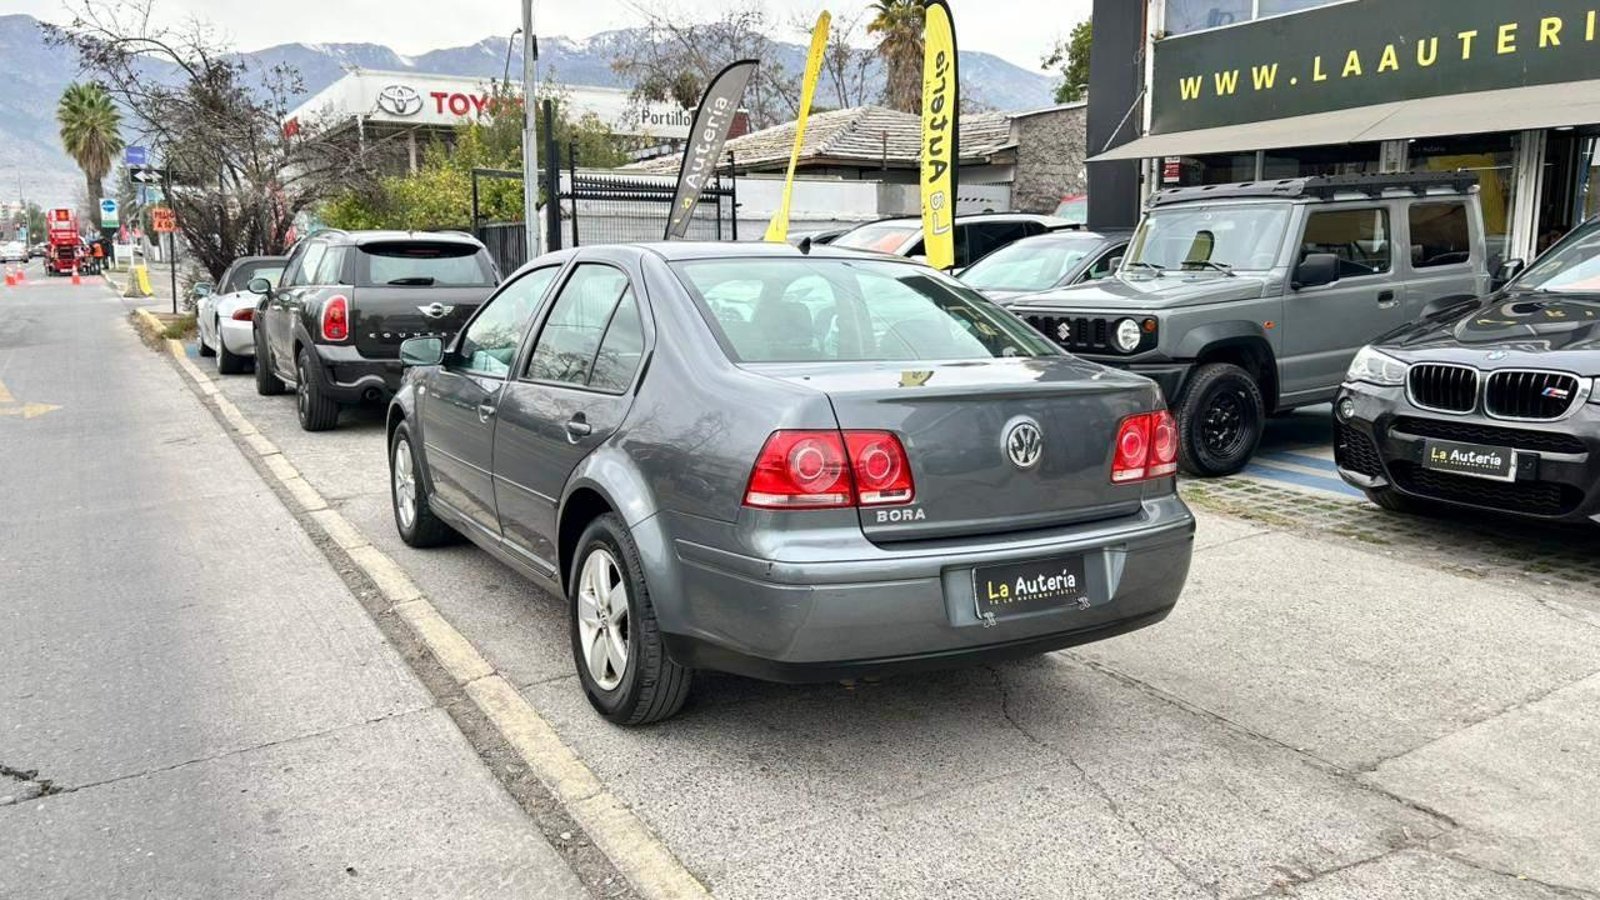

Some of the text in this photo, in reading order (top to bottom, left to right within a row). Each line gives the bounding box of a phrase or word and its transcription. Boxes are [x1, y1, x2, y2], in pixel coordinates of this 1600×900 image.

[642, 108, 691, 126] Portillo
[686, 97, 728, 189] Autería
[1431, 447, 1446, 460] La
[1450, 449, 1501, 466] Autería
[876, 508, 926, 522] BORA
[988, 569, 1076, 599] La Autería
